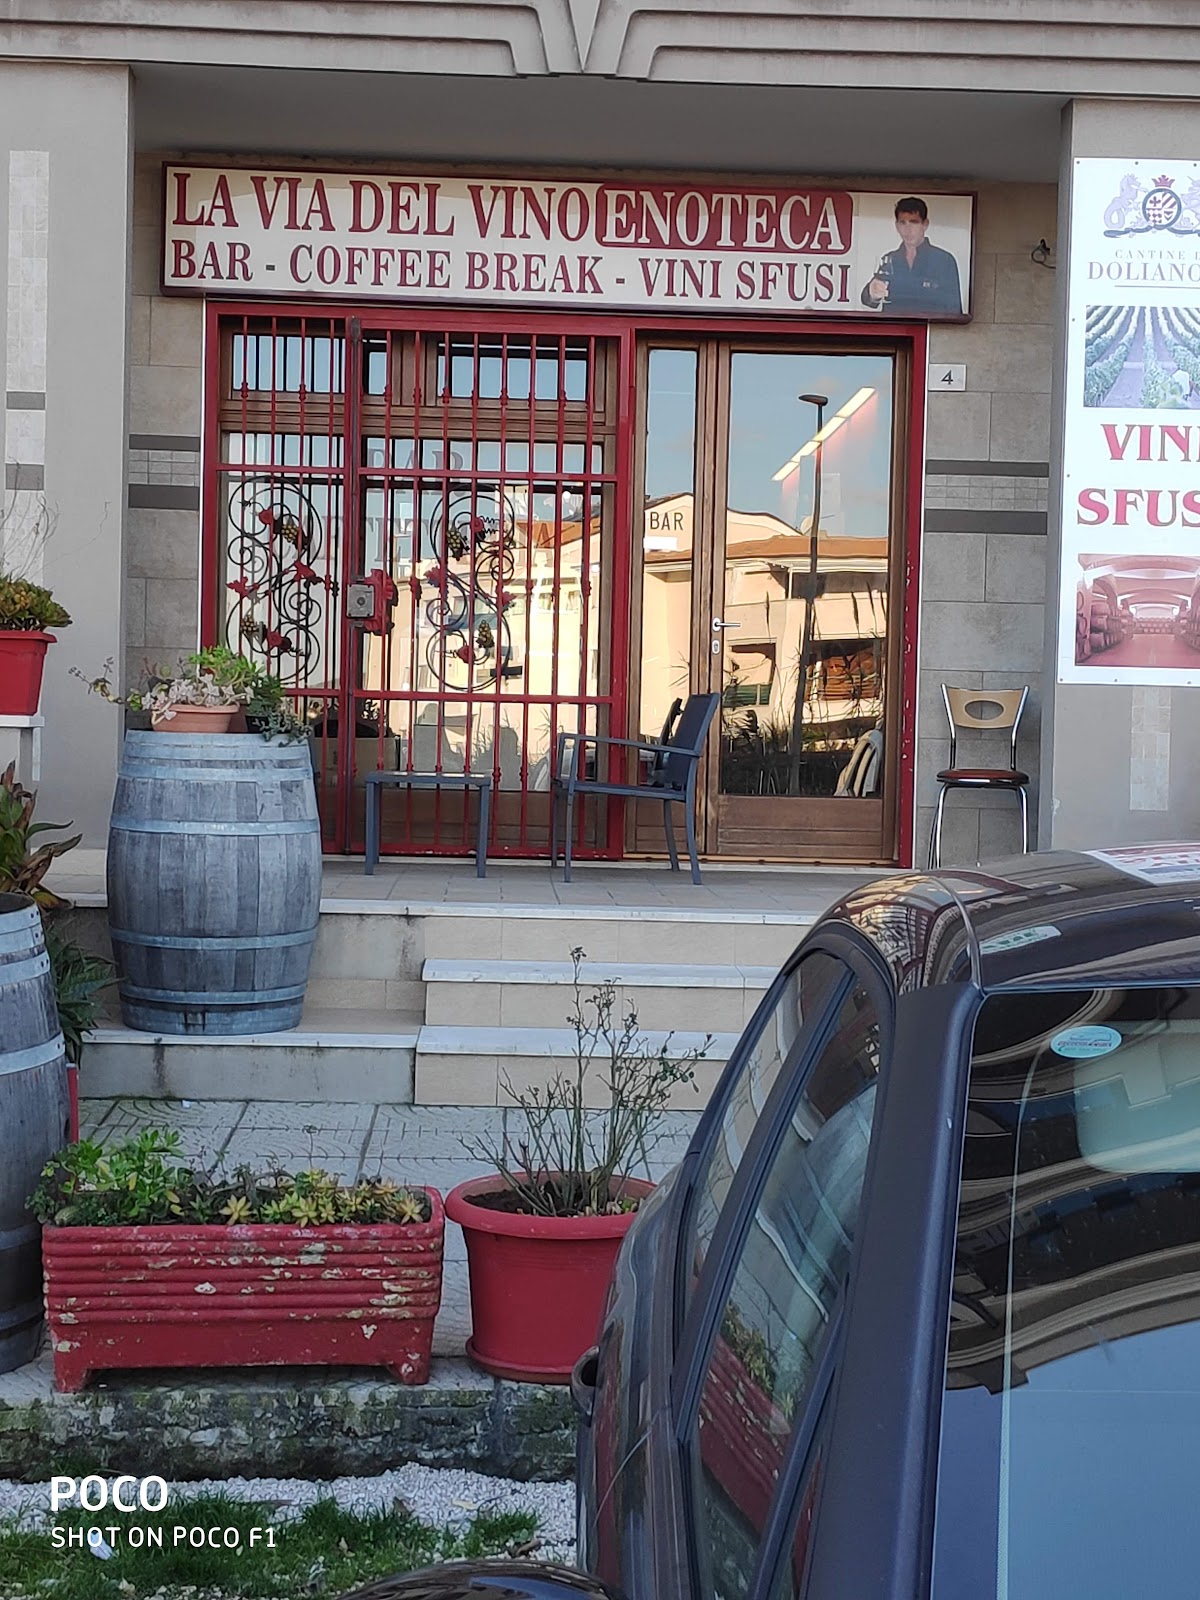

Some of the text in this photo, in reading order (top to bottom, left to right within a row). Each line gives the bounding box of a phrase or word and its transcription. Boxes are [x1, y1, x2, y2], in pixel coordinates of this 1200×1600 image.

[172, 172, 846, 251] LA VIA DEL VINO ENOTECA
[1115, 248, 1186, 261] CANTINE
[170, 238, 253, 282] BAR
[289, 243, 452, 289] COFFEE
[464, 250, 604, 294] BREAK
[638, 257, 723, 299] VINI
[736, 260, 852, 303] SFUSI
[941, 369, 954, 385] 4
[1100, 423, 1200, 463] VIN
[650, 511, 684, 531] BAR
